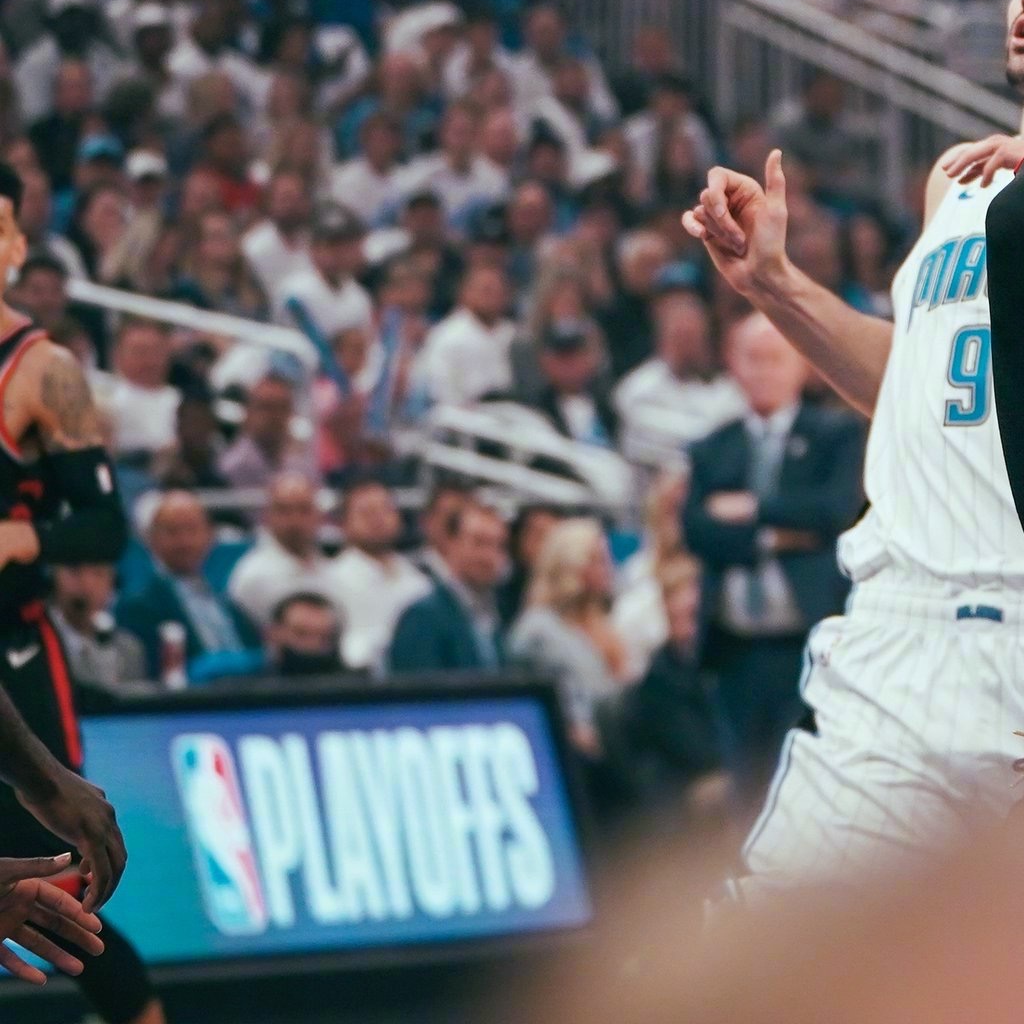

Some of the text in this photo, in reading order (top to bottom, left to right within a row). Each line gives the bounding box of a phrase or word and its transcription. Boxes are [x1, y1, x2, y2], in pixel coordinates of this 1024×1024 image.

[907, 232, 989, 334] MA
[943, 323, 992, 427] 9
[239, 721, 556, 929] PLAYOFFS
